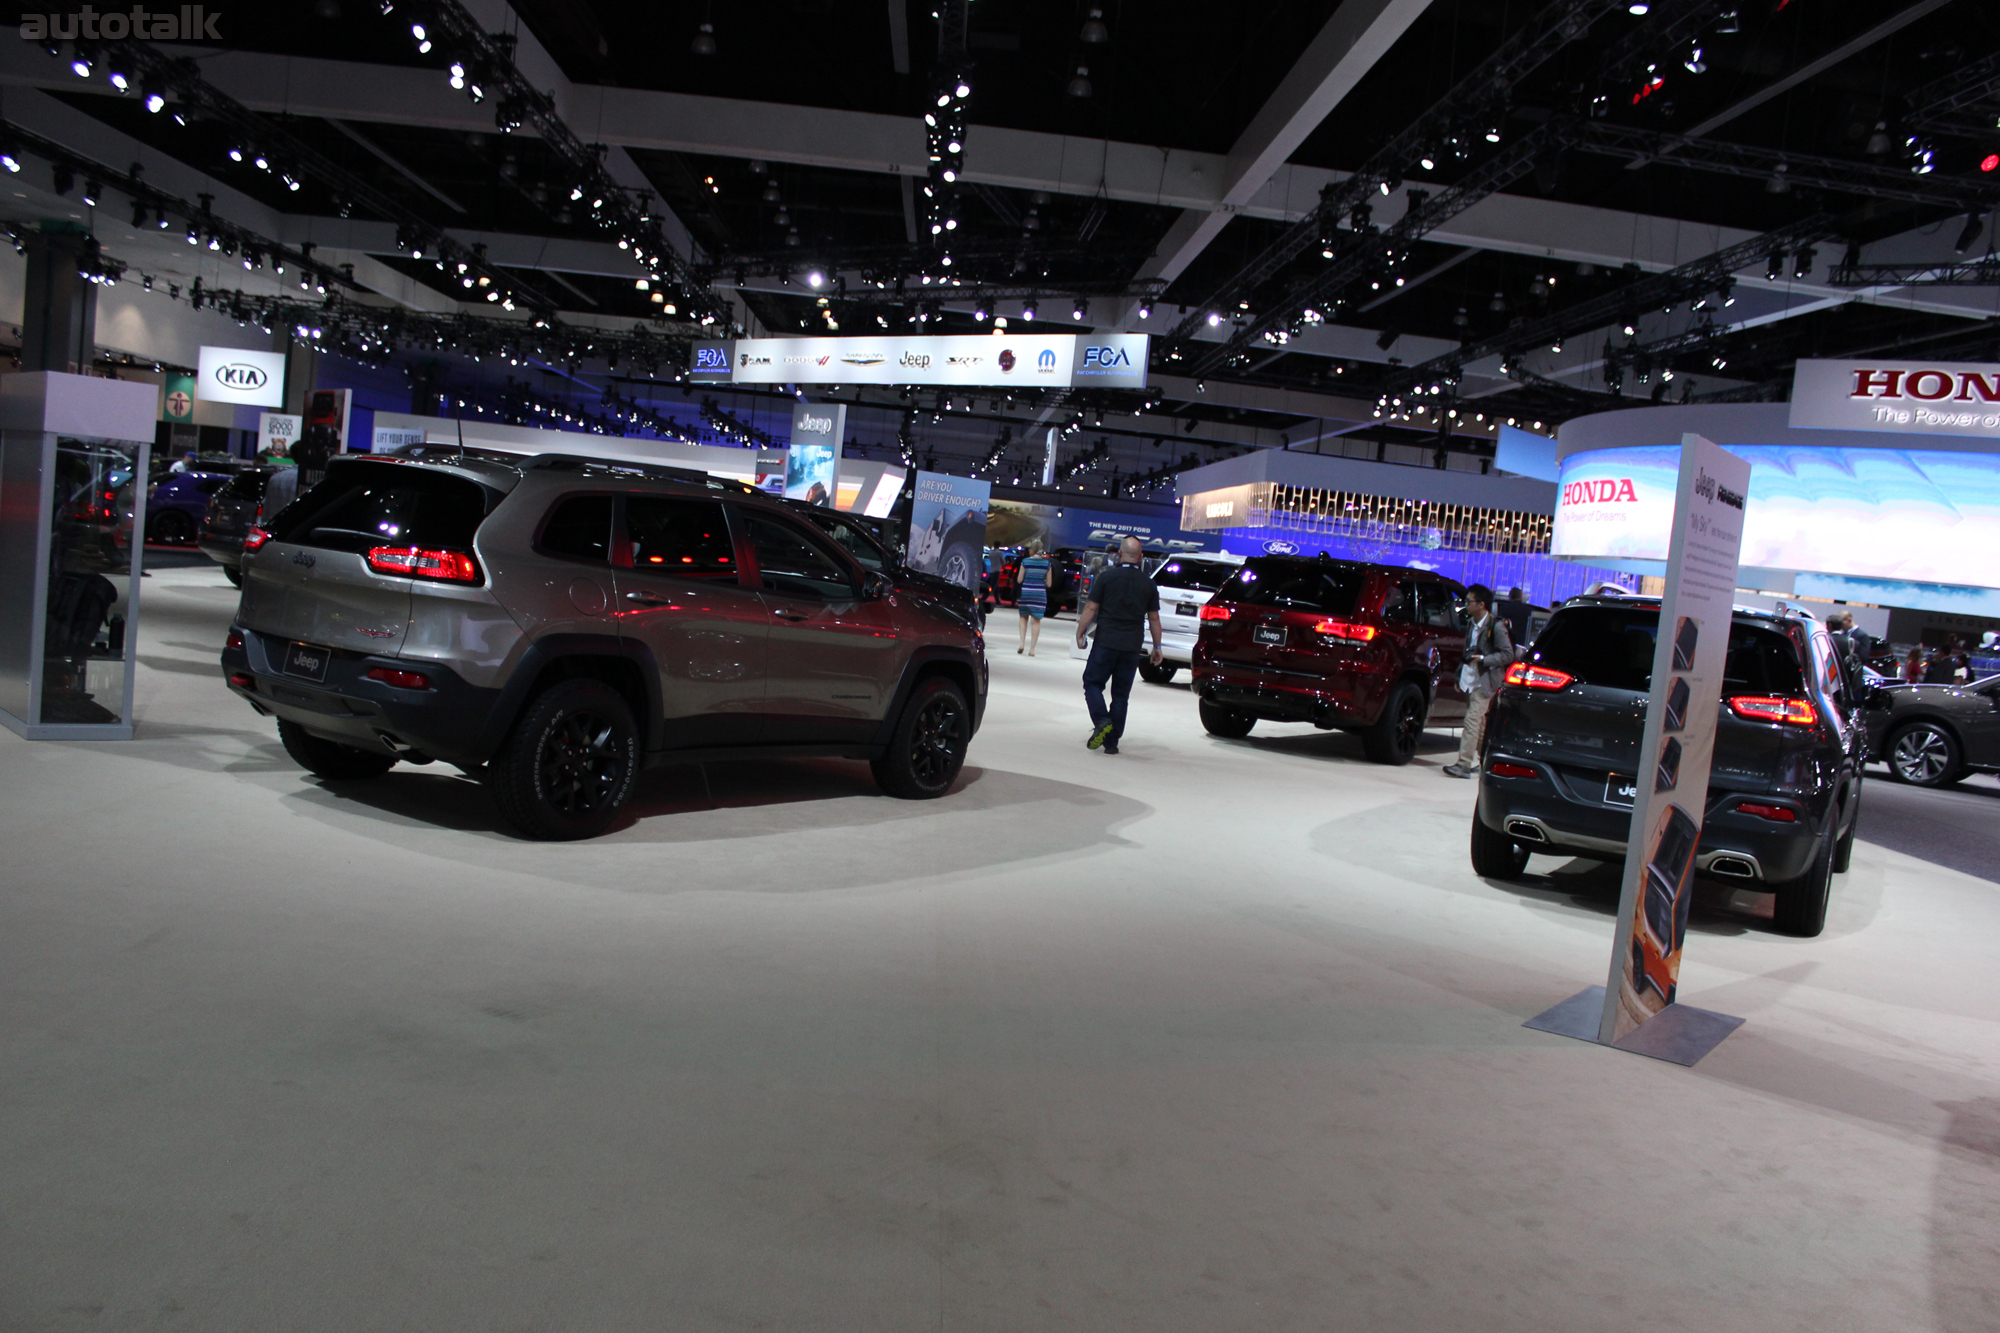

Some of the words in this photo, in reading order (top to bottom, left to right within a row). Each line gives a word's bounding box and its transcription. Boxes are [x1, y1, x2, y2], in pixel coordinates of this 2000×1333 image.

[900, 351, 930, 368] Jeep
[1084, 346, 1132, 368] FCA
[225, 368, 259, 385] KIA
[1850, 369, 2000, 402] HON
[797, 413, 832, 435] Jeep
[1872, 406, 1910, 423] The
[1914, 407, 1981, 426] Power
[1982, 413, 2000, 428] o
[269, 421, 293, 430] GOOD
[376, 433, 388, 443] LIFT
[389, 433, 403, 444] YOUR
[816, 450, 832, 459] Jeep
[921, 480, 935, 490] ARE
[936, 482, 953, 492] YOU
[1562, 478, 1638, 506] HONDA
[1695, 467, 1715, 504] Jeep
[917, 491, 944, 503] DRIVER
[945, 495, 981, 508] ENOUGH?
[1571, 512, 1587, 522] Power
[1588, 510, 1595, 521] of
[1596, 510, 1627, 521] Dreams
[1089, 521, 1101, 529] THE
[1269, 541, 1293, 554] Ford
[1180, 606, 1194, 614] Jeep
[1260, 630, 1280, 641] Jeep
[294, 651, 319, 672] Jeep
[1618, 783, 1637, 797] Je
